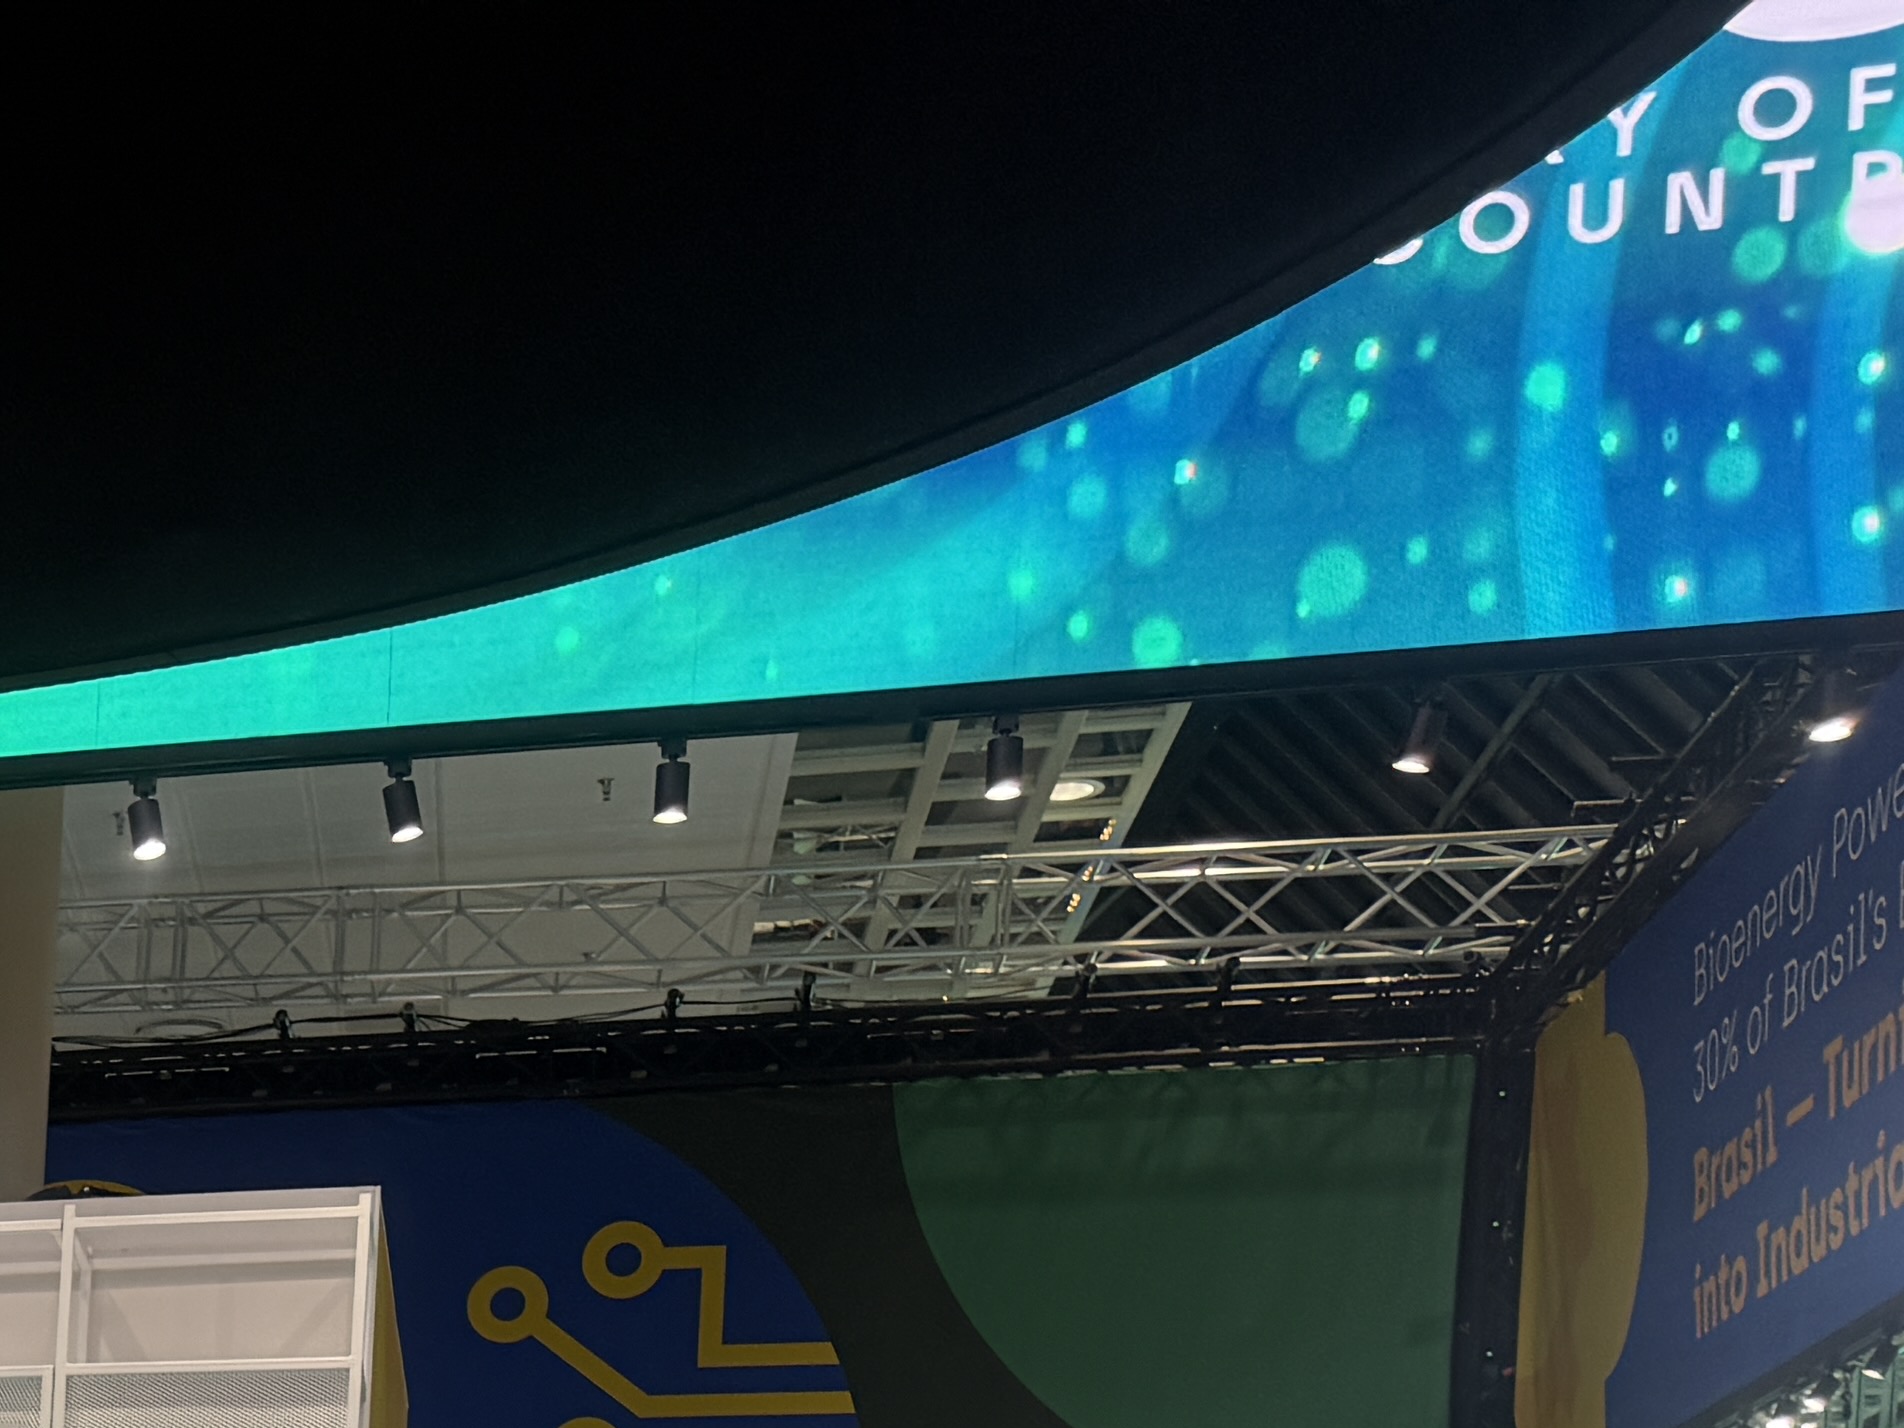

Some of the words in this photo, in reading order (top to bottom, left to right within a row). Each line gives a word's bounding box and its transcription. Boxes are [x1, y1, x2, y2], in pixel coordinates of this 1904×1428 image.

[1738, 63, 1897, 141] OF
[1373, 150, 1904, 265] OUNT
[1693, 845, 1823, 1007] Bioenergy
[1693, 1009, 1740, 1104] 30%
[1747, 972, 1774, 1056] of
[1782, 888, 1888, 1030] Brasil's
[1693, 1083, 1779, 1223] Brasil
[1694, 1254, 1748, 1339] into
